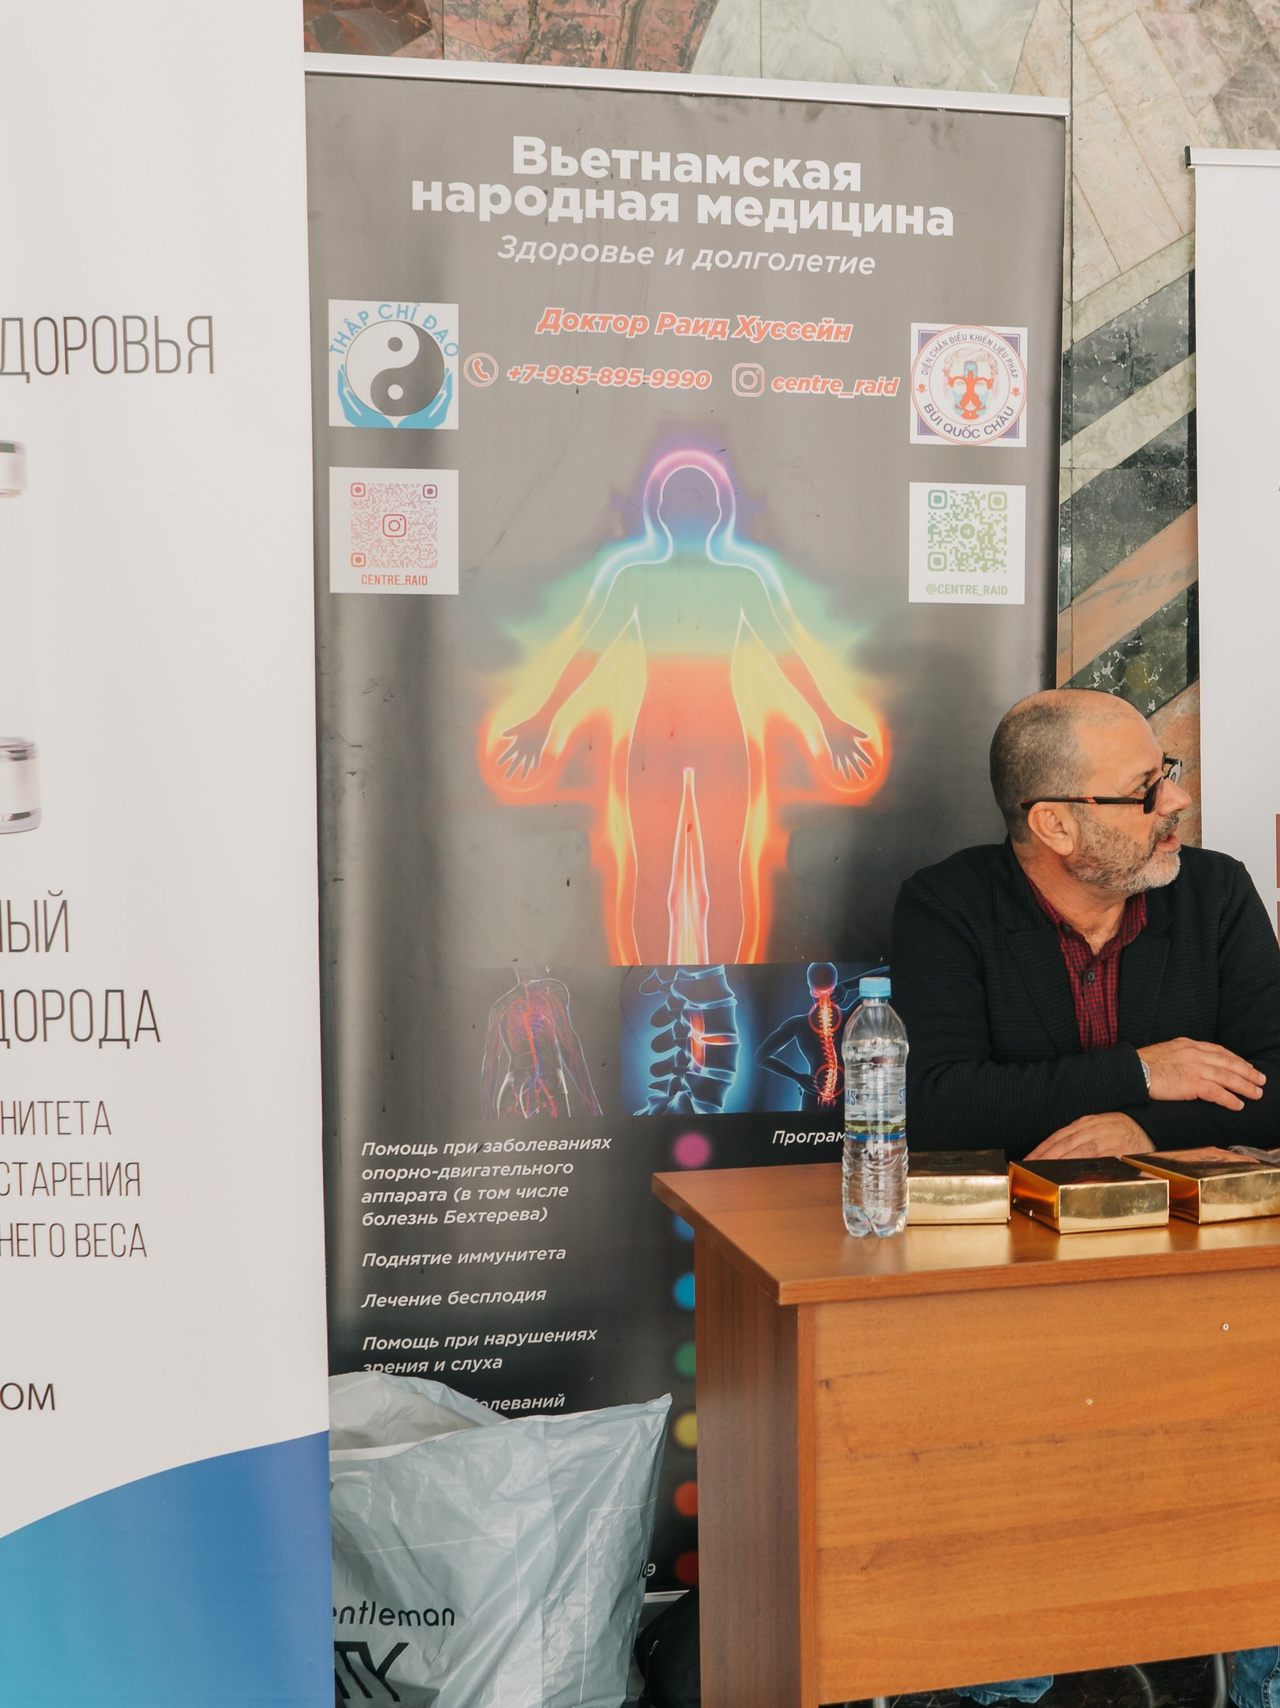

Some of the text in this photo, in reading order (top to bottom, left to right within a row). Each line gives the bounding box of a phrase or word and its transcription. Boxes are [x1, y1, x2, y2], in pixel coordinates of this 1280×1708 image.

[513, 135, 861, 192] Вьетнамская
[412, 180, 954, 237] народная медицина
[497, 235, 876, 275] Здоровье и долголетие
[535, 307, 854, 343] Доктор Раид Хуссейн
[507, 364, 712, 389] +7-985-895-9990
[772, 375, 900, 398] centre_raid
[361, 574, 428, 586] CENTRE_RAID
[926, 583, 1008, 596] @CENTRE_RAID
[0, 890, 69, 952] ЫЙ
[0, 1100, 112, 1135] НИТЕТА
[361, 1137, 612, 1157] Помощь при заболеваниях
[0, 1162, 141, 1197] СТАРЕНИЯ
[361, 1161, 574, 1181] опорно-двигательного
[361, 1184, 569, 1204] аппарата (в том числе
[361, 1207, 548, 1227] болезнь Бехтерева)
[75, 1223, 147, 1258] ВЕСА
[362, 1248, 567, 1269] Поднятие иммунитета
[361, 1288, 547, 1309] Лечение бесплодия
[362, 1328, 598, 1352] Помощь при нарушениях
[434, 1360, 445, 1372] и
[451, 1357, 503, 1373] слуха
[478, 1393, 566, 1411] олеваний
